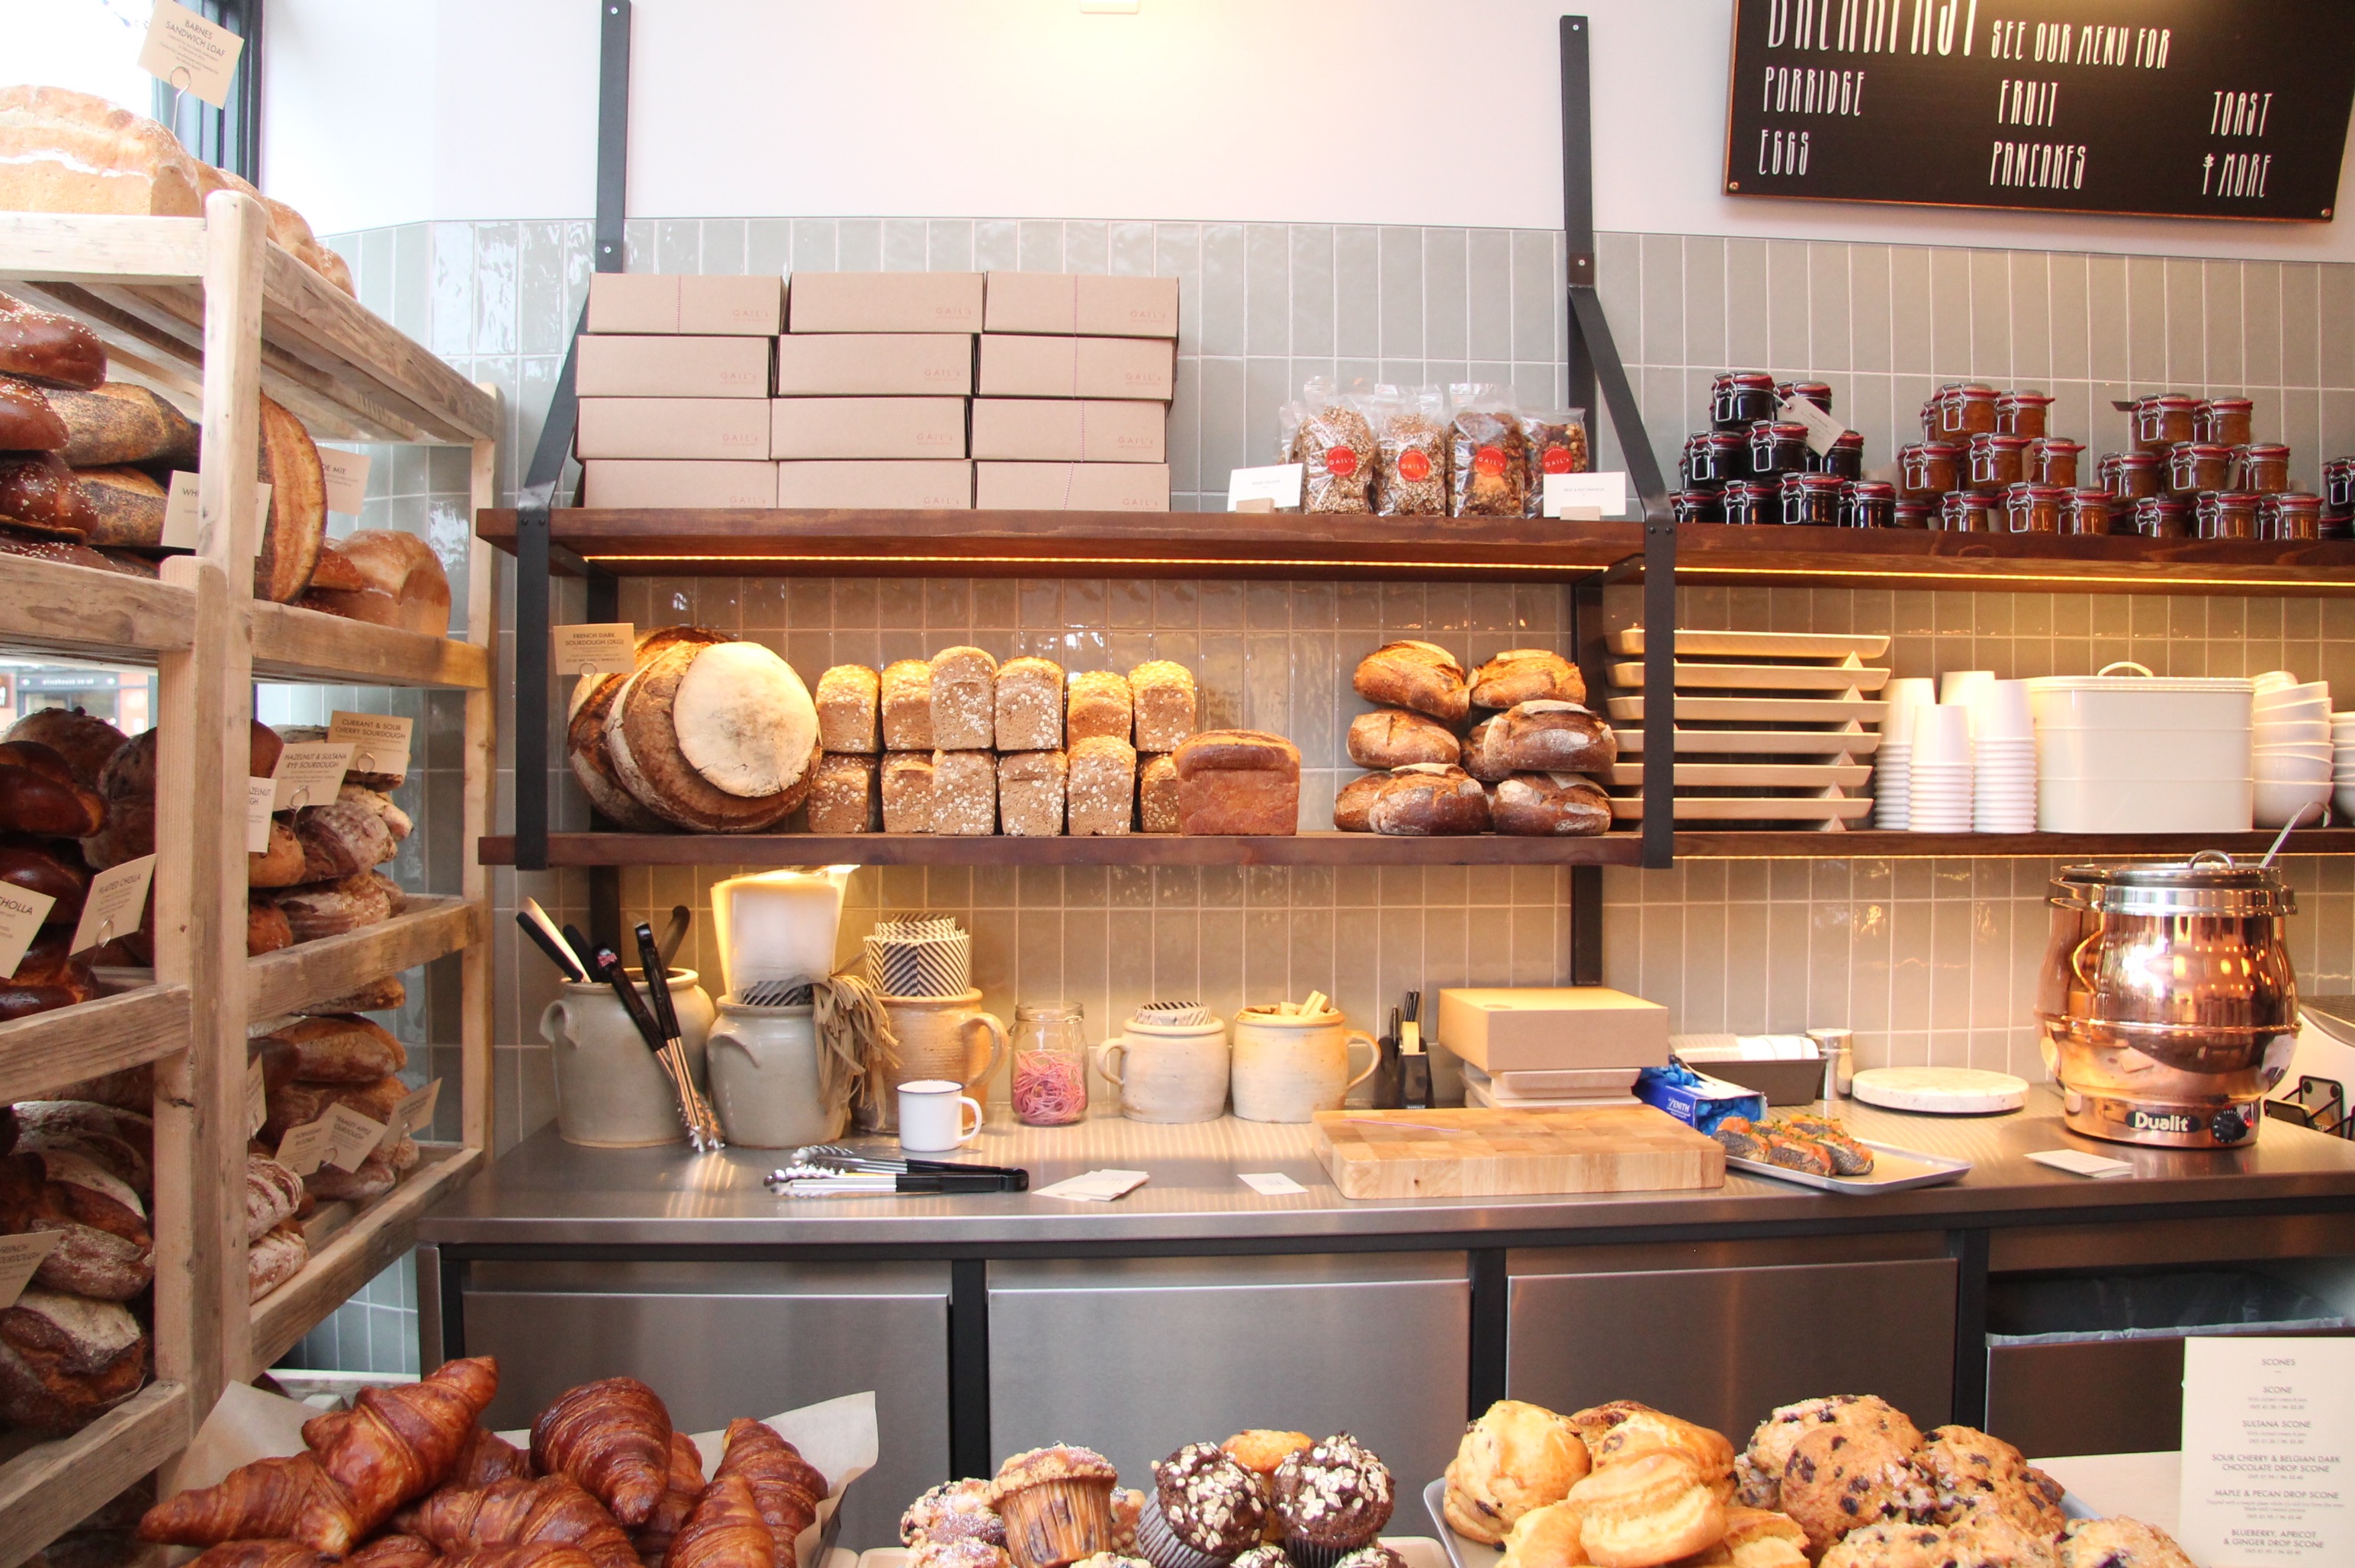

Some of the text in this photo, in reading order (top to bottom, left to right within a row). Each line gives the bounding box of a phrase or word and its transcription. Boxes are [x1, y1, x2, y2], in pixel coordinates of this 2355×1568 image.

[165, 21, 207, 47] SANDWICH
[207, 42, 226, 56] LOAF
[185, 19, 214, 40] BARNES
[1990, 19, 2171, 69] SEE OUR MENU FOR
[1763, 66, 1865, 117] PORRIDGE
[1998, 79, 2058, 127] FRUIT
[2210, 91, 2273, 137] TOAST
[1758, 128, 1809, 175] EGGS
[1989, 140, 2087, 190] PANCAKES
[2217, 153, 2272, 198] MORE
[333, 466, 346, 474] MIE
[336, 726, 406, 739] CHERRY SOURDOUGH
[342, 718, 374, 728] CURRANT
[1668, 1097, 1690, 1113] ZENITH
[2135, 1111, 2189, 1132] Dualit
[2222, 1464, 2272, 1472] CHOCOLATE
[2293, 1540, 2324, 1548] SCONE
